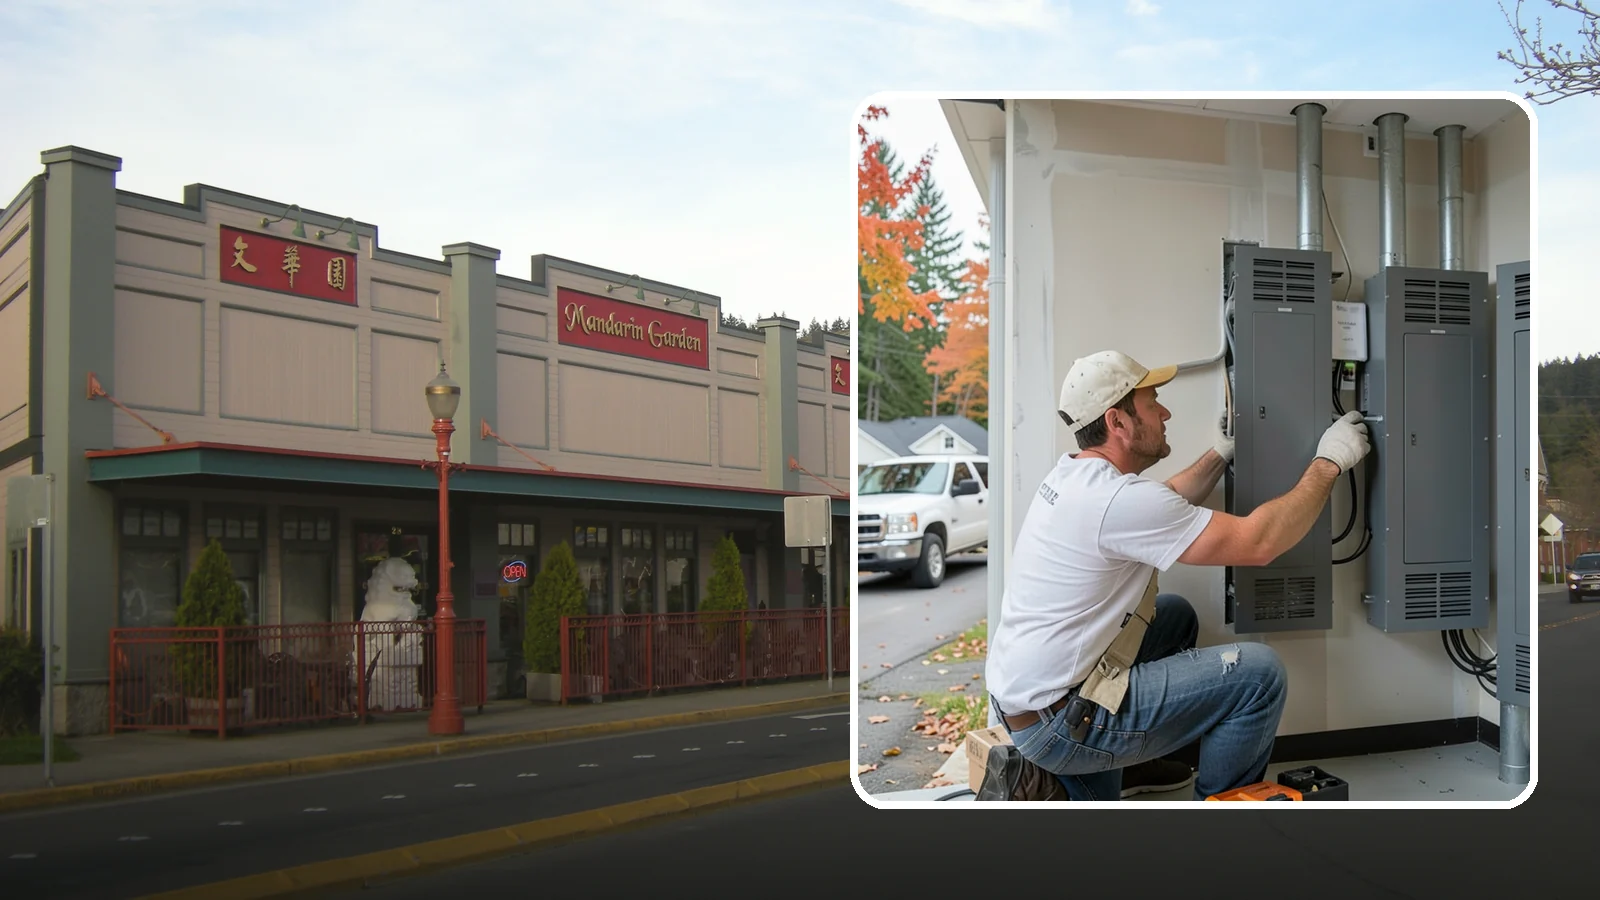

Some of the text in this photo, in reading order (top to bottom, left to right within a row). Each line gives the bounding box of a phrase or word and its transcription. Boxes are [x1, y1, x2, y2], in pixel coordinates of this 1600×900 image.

[231, 236, 346, 290] 文華園
[564, 302, 701, 352] Mandarin Garden
[503, 565, 527, 578] OPEN
